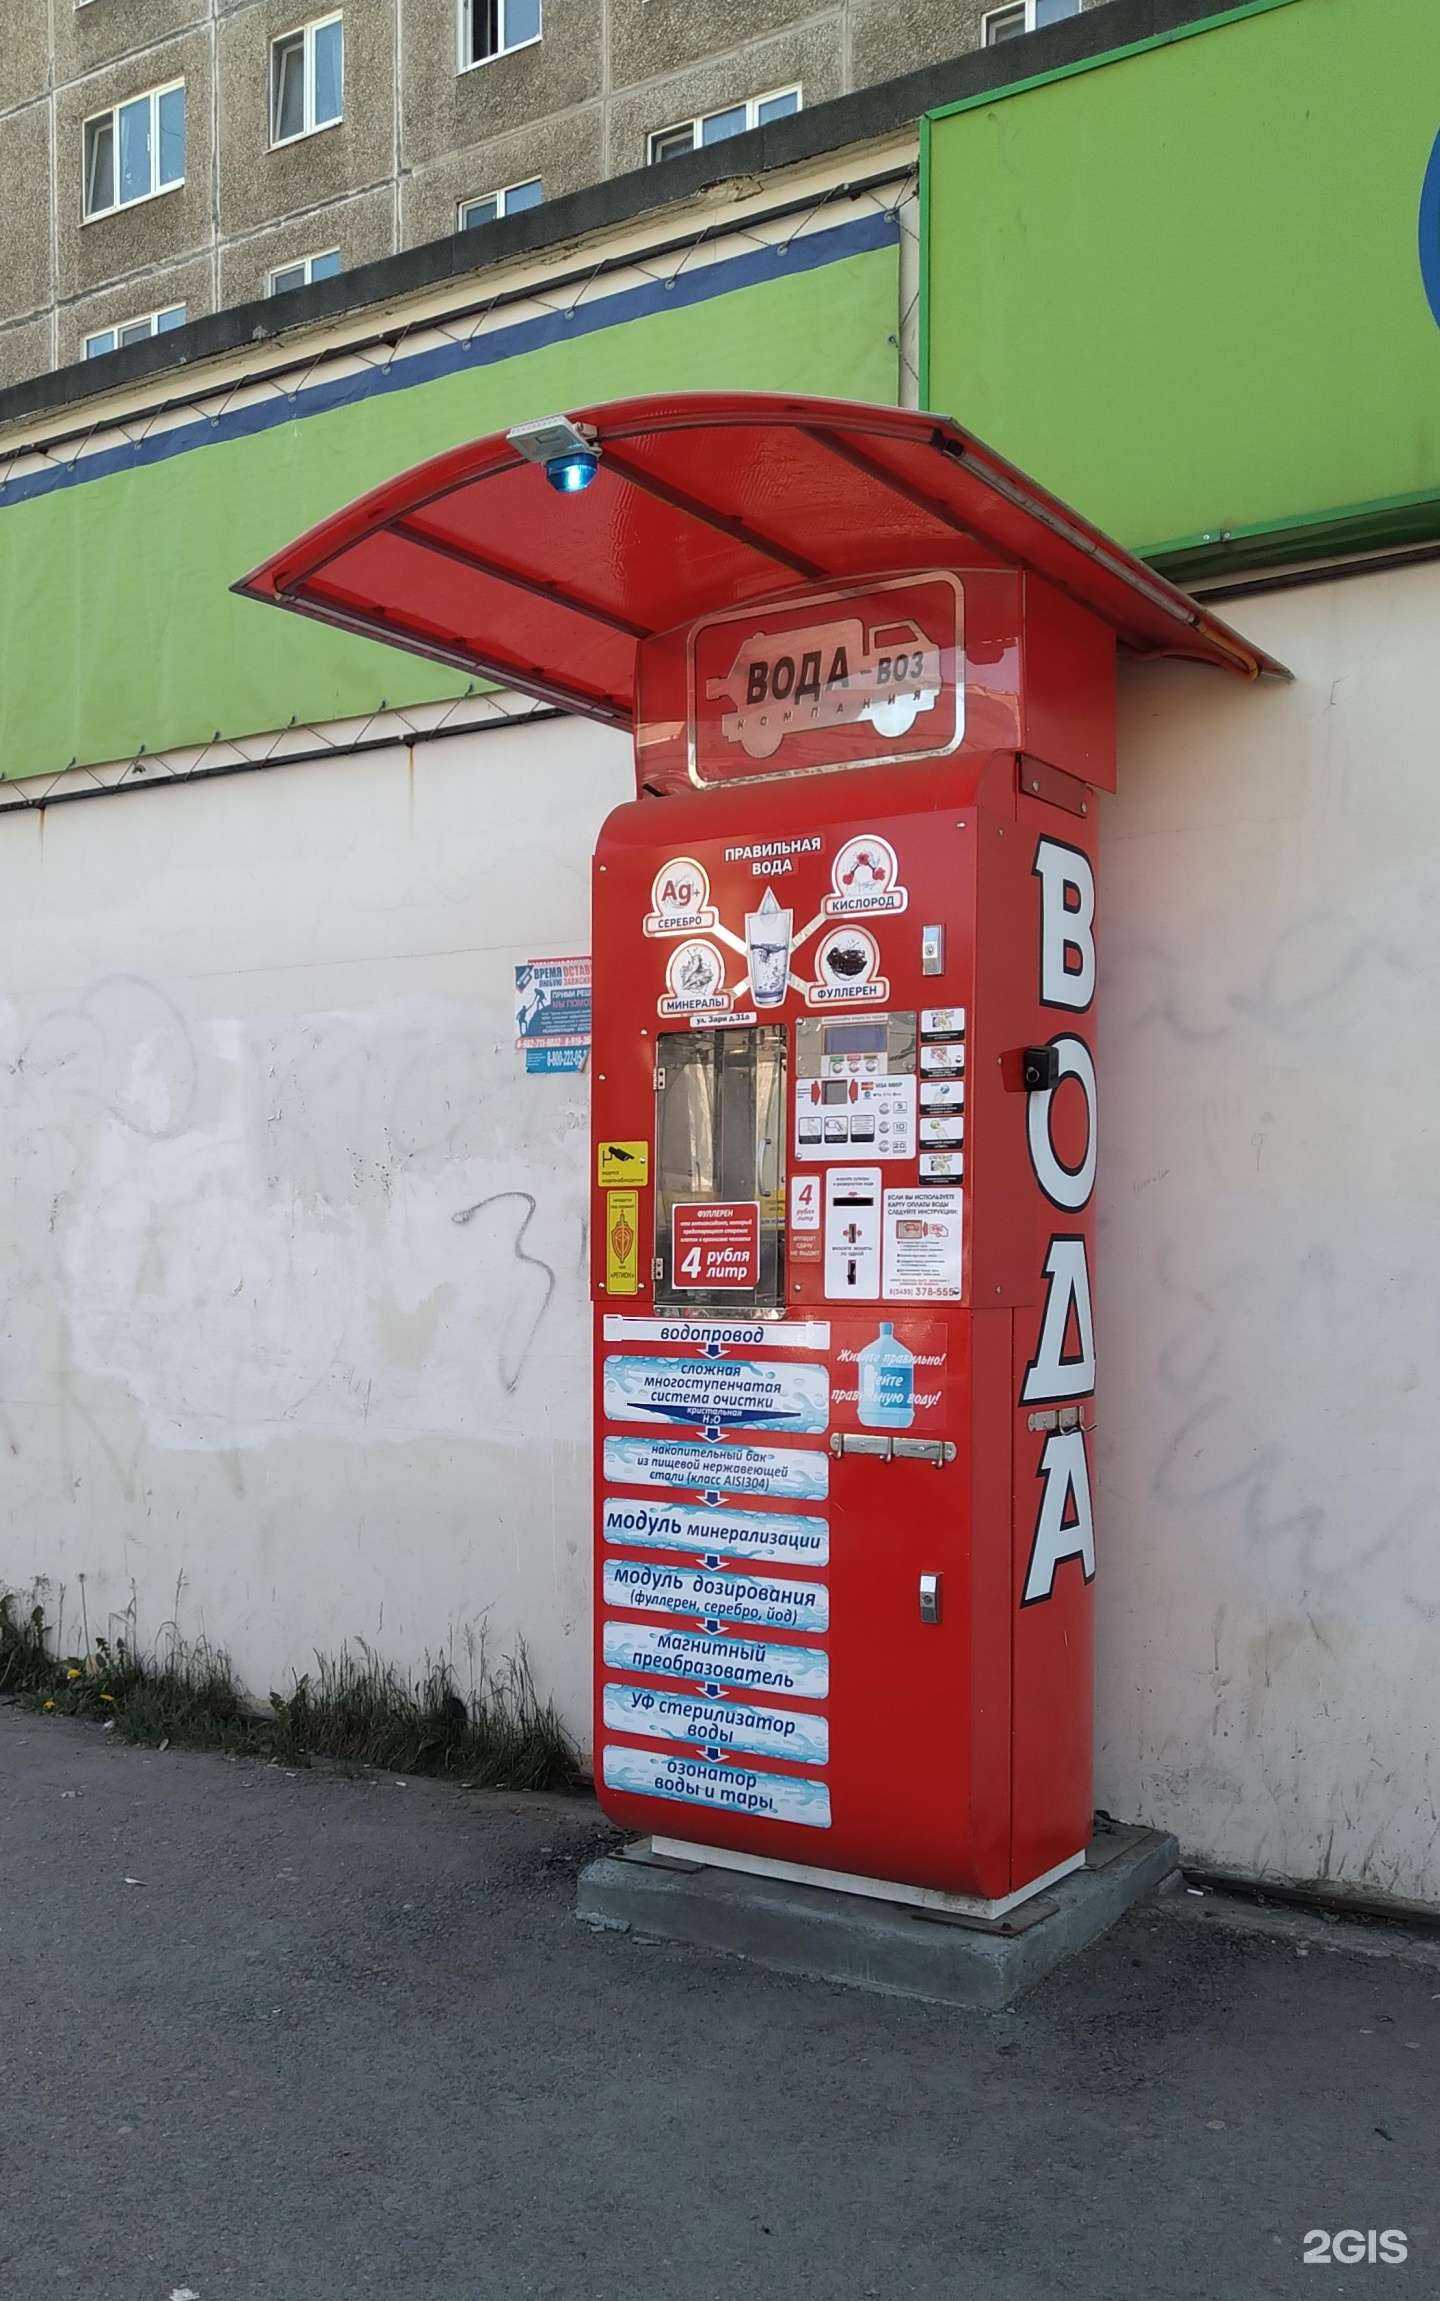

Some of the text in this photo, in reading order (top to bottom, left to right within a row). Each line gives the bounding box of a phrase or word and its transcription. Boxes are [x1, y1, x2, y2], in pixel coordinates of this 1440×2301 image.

[725, 837, 821, 861] ПРАВИЛЬНАЯ
[752, 859, 792, 875] ВОДА
[832, 896, 894, 911] КИСЛОРОД
[658, 916, 702, 928] СЕРЕБРО
[534, 966, 562, 980] ВРЕМЯ
[818, 985, 877, 999] ФУЛЛЕРЕН
[666, 997, 724, 1011] МИНЕРАЛЫ
[709, 1015, 727, 1024] Зари
[895, 1122, 904, 1130] 10
[799, 1184, 813, 1206] 4
[697, 1209, 734, 1218] ФУЛЛЕРЕН
[681, 1246, 702, 1279] 4
[707, 1248, 750, 1265] рубля
[706, 1265, 748, 1280] литр
[660, 1325, 764, 1343] водопровод
[882, 1352, 947, 1366] правильно!
[681, 1363, 741, 1377] сложная
[644, 1377, 782, 1394] многоступенчатая
[651, 1390, 773, 1408] система очистки
[907, 1390, 942, 1409] воду!
[686, 1407, 742, 1417] кристальная
[651, 1445, 767, 1462] накопительный бак
[637, 1458, 788, 1478] из пищевой нержавеющей
[649, 1470, 770, 1491] стали (класс AISI304)
[607, 1510, 821, 1549] модуль минерализации
[614, 1567, 816, 1607] модуль дозирования
[630, 1589, 798, 1626] (фуллерен, серебро, йод)
[657, 1634, 766, 1662] магнитный
[632, 1652, 794, 1688] преобразователь
[631, 1692, 796, 1737] УФ стерилизатор
[687, 1723, 733, 1743] воды
[667, 1761, 757, 1790] озонатор
[654, 1776, 773, 1810] воды и тары
